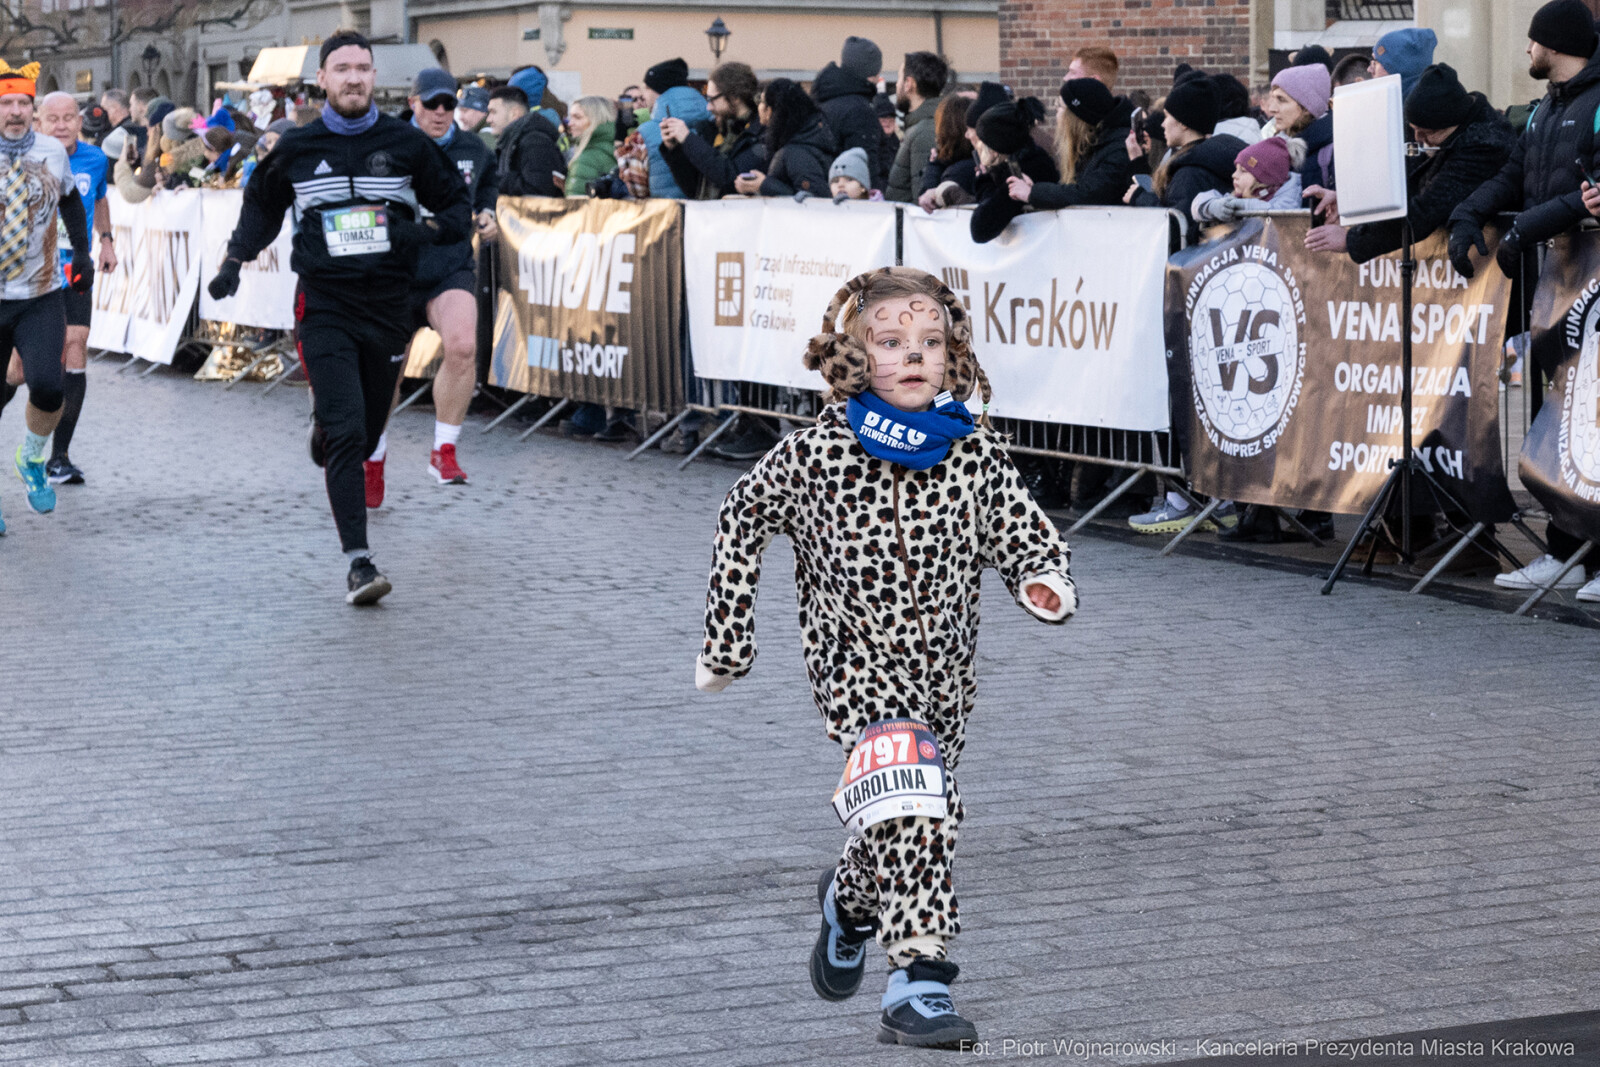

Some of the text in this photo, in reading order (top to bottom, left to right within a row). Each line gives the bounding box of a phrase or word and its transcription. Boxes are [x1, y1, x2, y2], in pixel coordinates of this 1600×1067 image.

[338, 229, 375, 242] TOMASZ
[340, 212, 370, 229] 960
[1184, 247, 1239, 321] FUNDACJA
[1242, 244, 1277, 267] VENA
[1284, 267, 1307, 326] SPORT
[1358, 258, 1469, 290] FUNACJA
[983, 275, 1118, 351] Kraków
[1327, 300, 1494, 346] VENA SPORT
[1565, 277, 1600, 350] FUNDAC
[575, 342, 628, 379] SPORT
[1209, 308, 1280, 395] VS
[1215, 347, 1235, 364] VENA
[1246, 339, 1272, 358] SPORT
[1220, 438, 1262, 458] IMPREZ
[1263, 342, 1307, 451] SPORTOWYCH
[1366, 404, 1429, 436] IMPEZ
[859, 424, 920, 453] SYLWESTROWY
[1558, 366, 1577, 489] ORGANIZACJA
[1328, 441, 1464, 480] SPORTOYCH
[849, 733, 911, 781] 2797
[843, 768, 927, 813] KAROLINA
